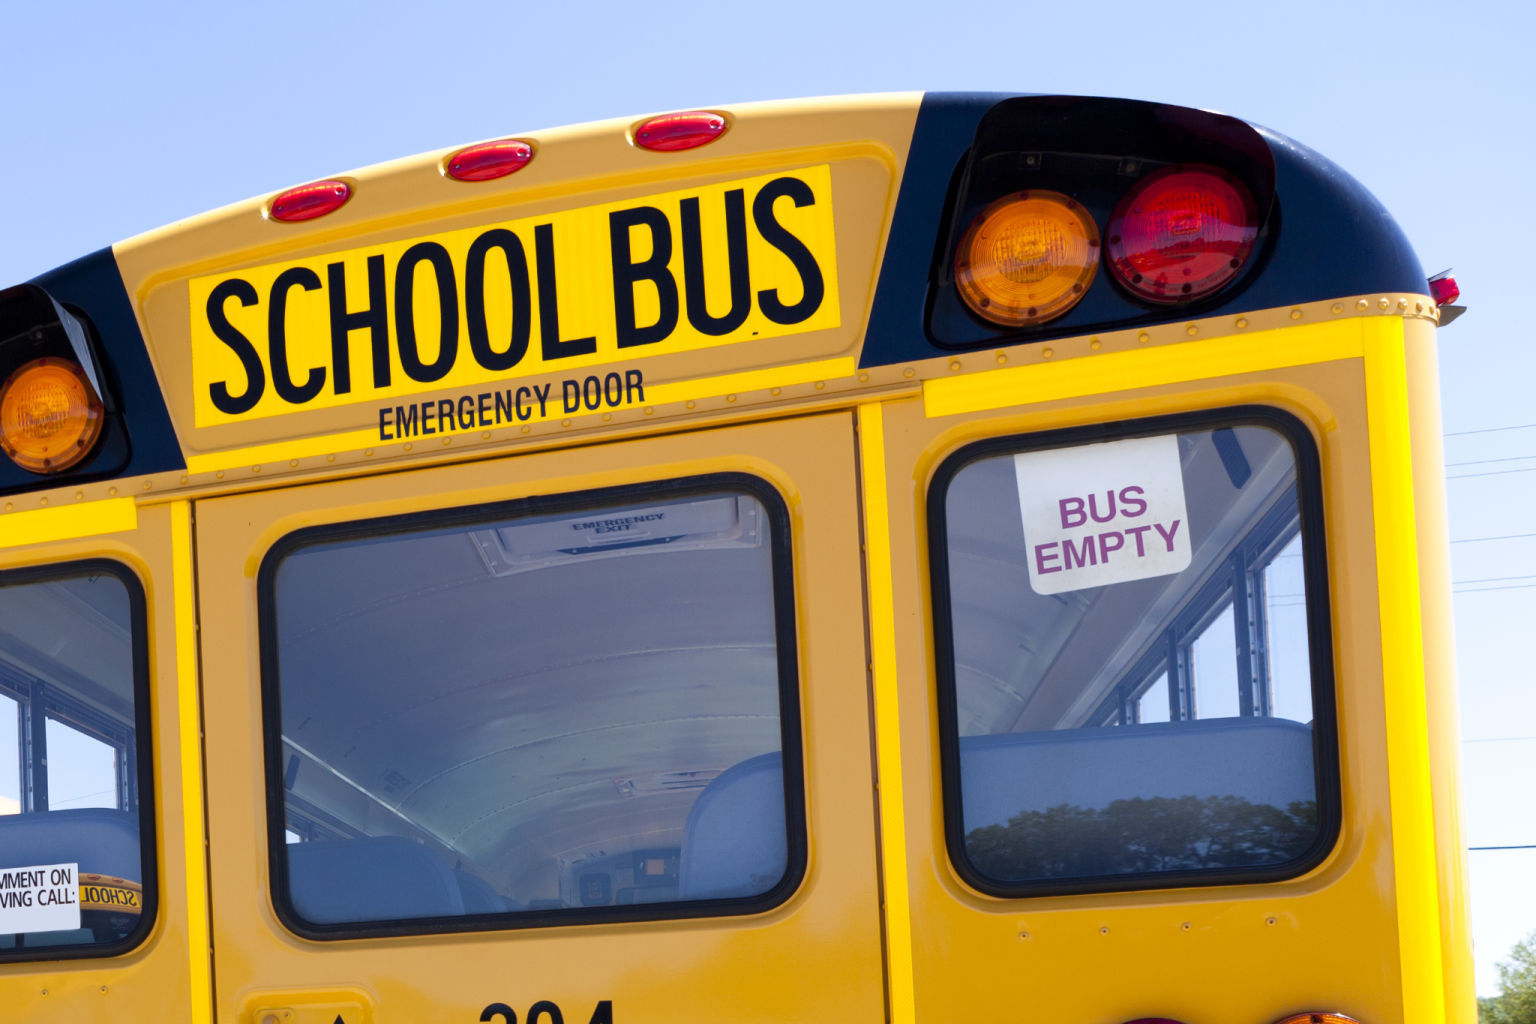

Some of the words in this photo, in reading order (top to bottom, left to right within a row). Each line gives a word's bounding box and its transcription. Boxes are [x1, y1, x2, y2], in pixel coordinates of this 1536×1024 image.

[207, 222, 598, 415] SCHOOL
[609, 175, 825, 350] BUS
[378, 382, 552, 441] EMERGENCY
[562, 368, 645, 414] DOOR
[572, 513, 665, 531] EMERGENCY
[1058, 485, 1148, 530] BUS
[595, 524, 631, 534] EXIT
[1034, 519, 1181, 575] EMPTY
[50, 868, 72, 886] ON
[37, 888, 76, 906] CALL:
